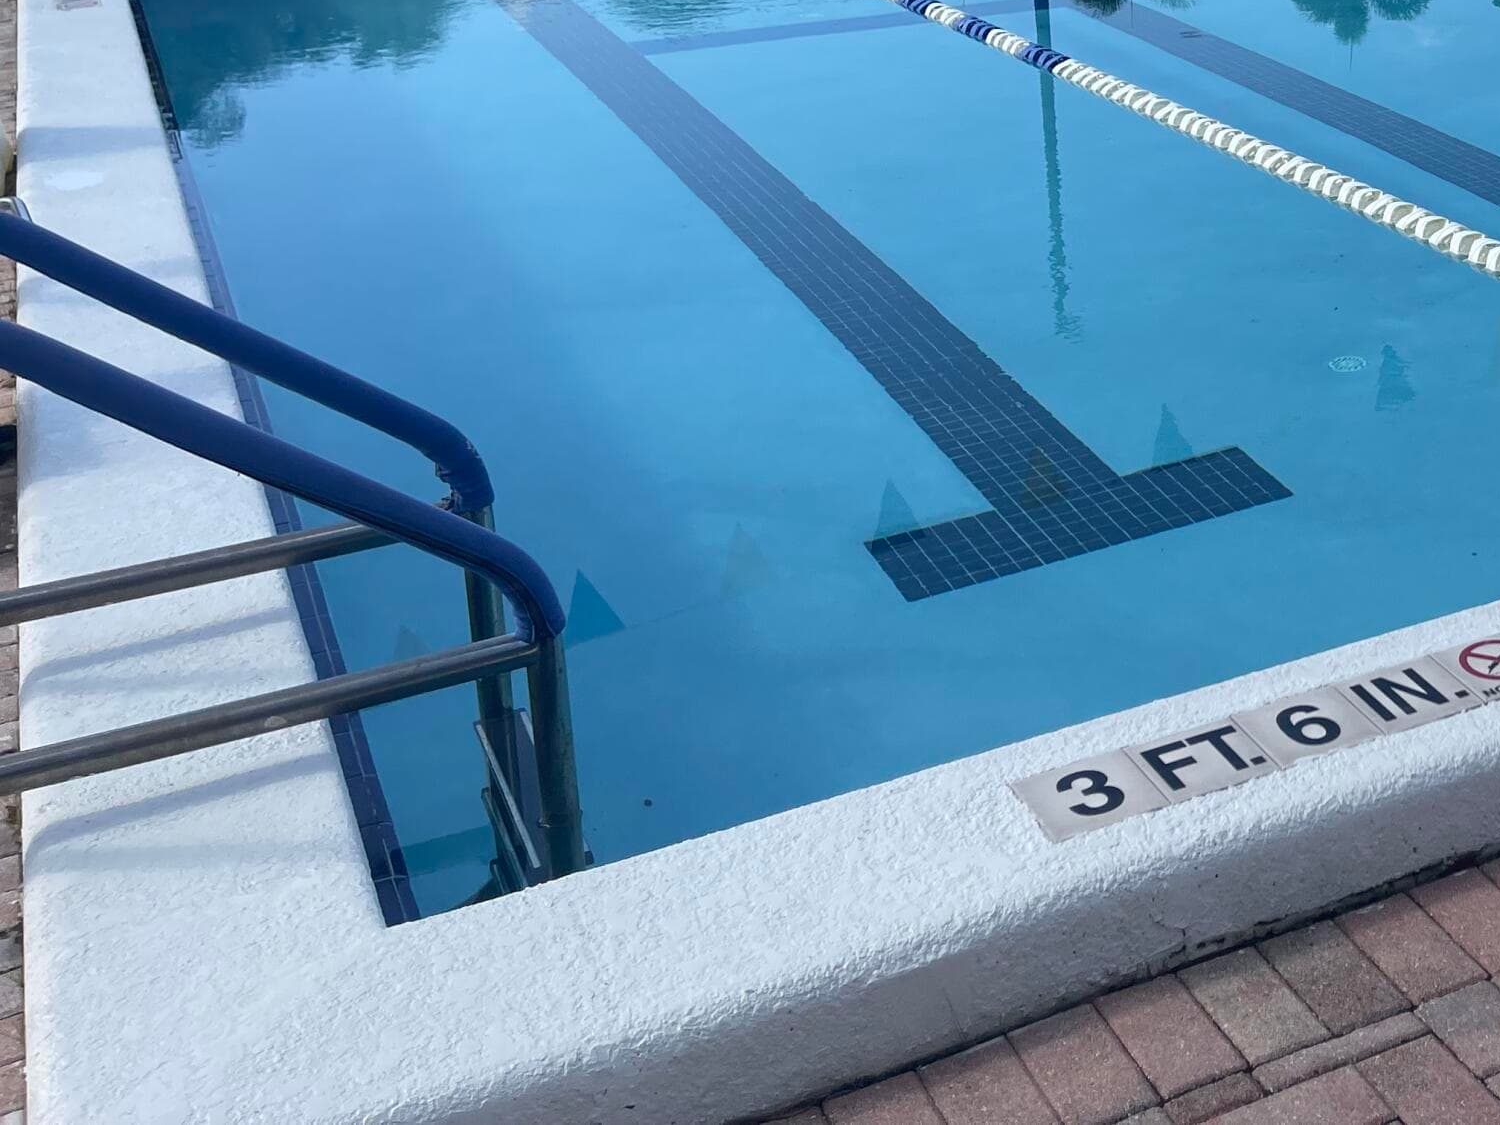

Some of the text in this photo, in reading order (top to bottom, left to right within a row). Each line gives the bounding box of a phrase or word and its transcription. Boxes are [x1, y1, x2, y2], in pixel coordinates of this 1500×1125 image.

[1056, 668, 1470, 816] 3 FT. 6 IN.
